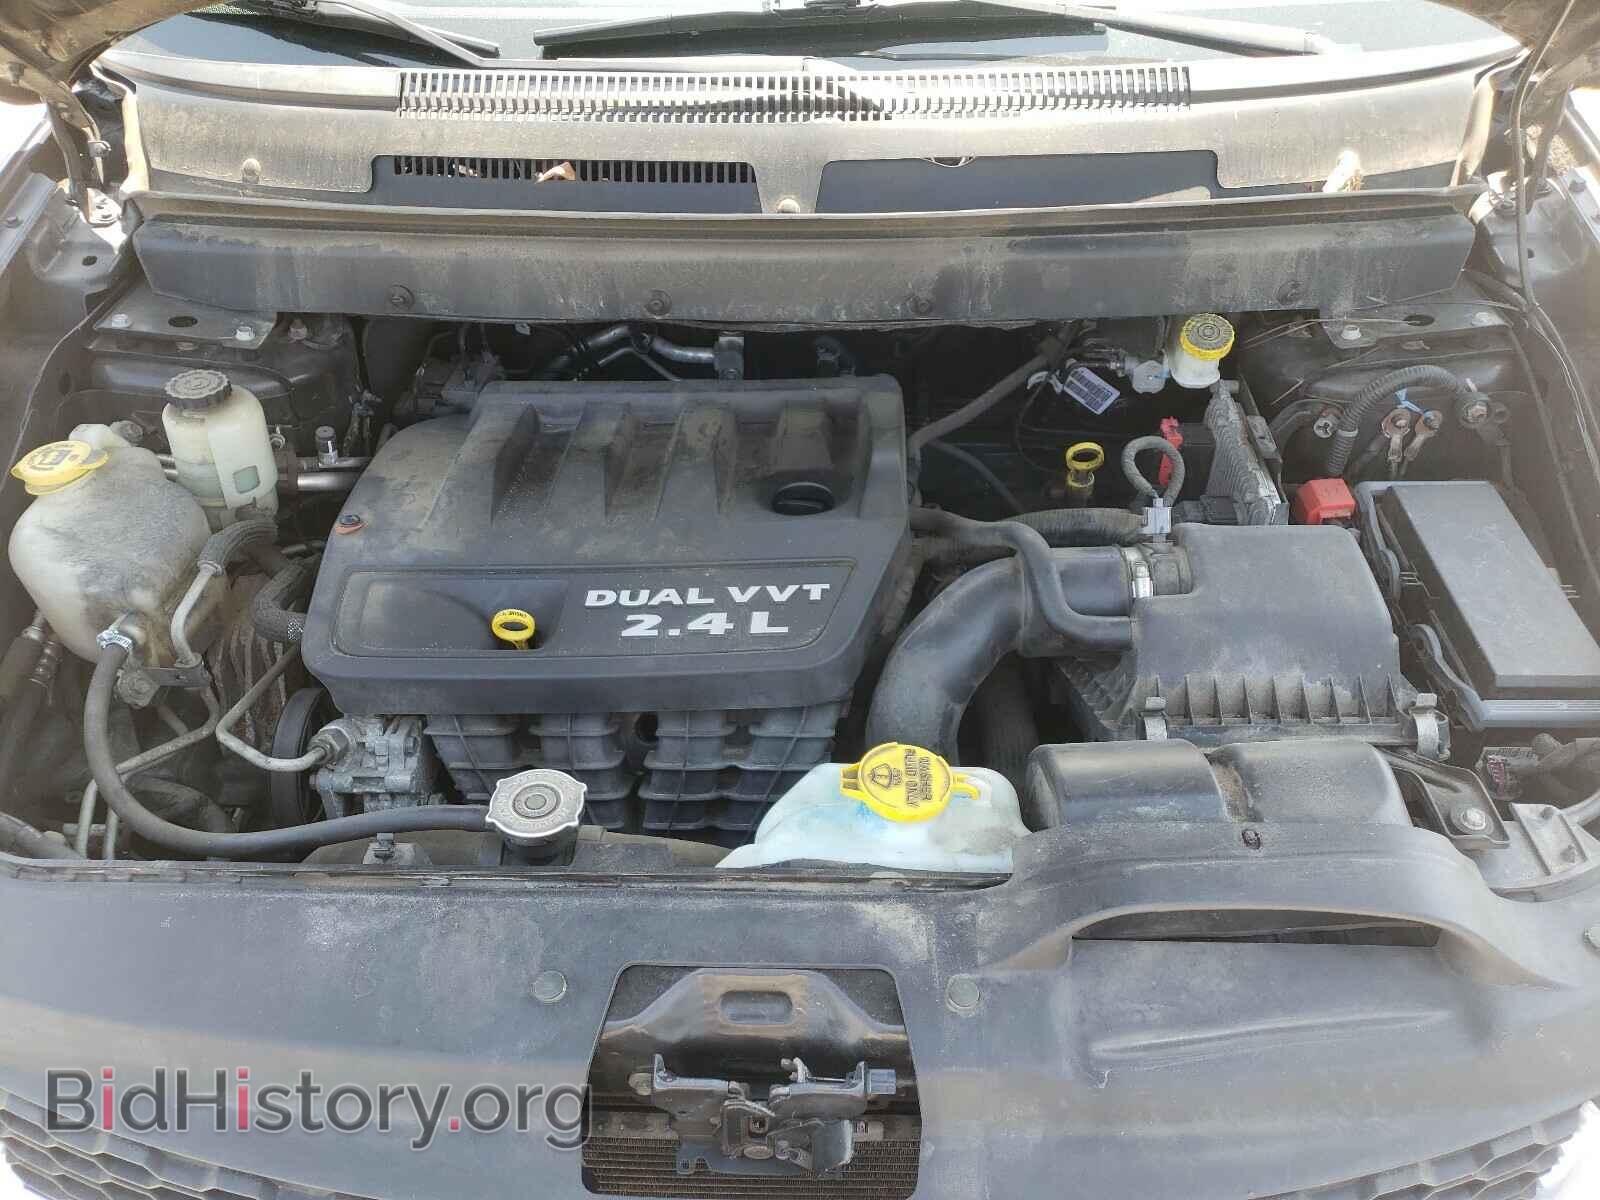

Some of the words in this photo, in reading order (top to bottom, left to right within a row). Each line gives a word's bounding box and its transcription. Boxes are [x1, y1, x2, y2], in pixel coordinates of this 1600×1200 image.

[584, 588, 716, 607] DUAL
[727, 583, 831, 603] VVT
[904, 748, 918, 777] FLUID
[919, 756, 934, 801] WASHER
[904, 780, 921, 808] ONLY
